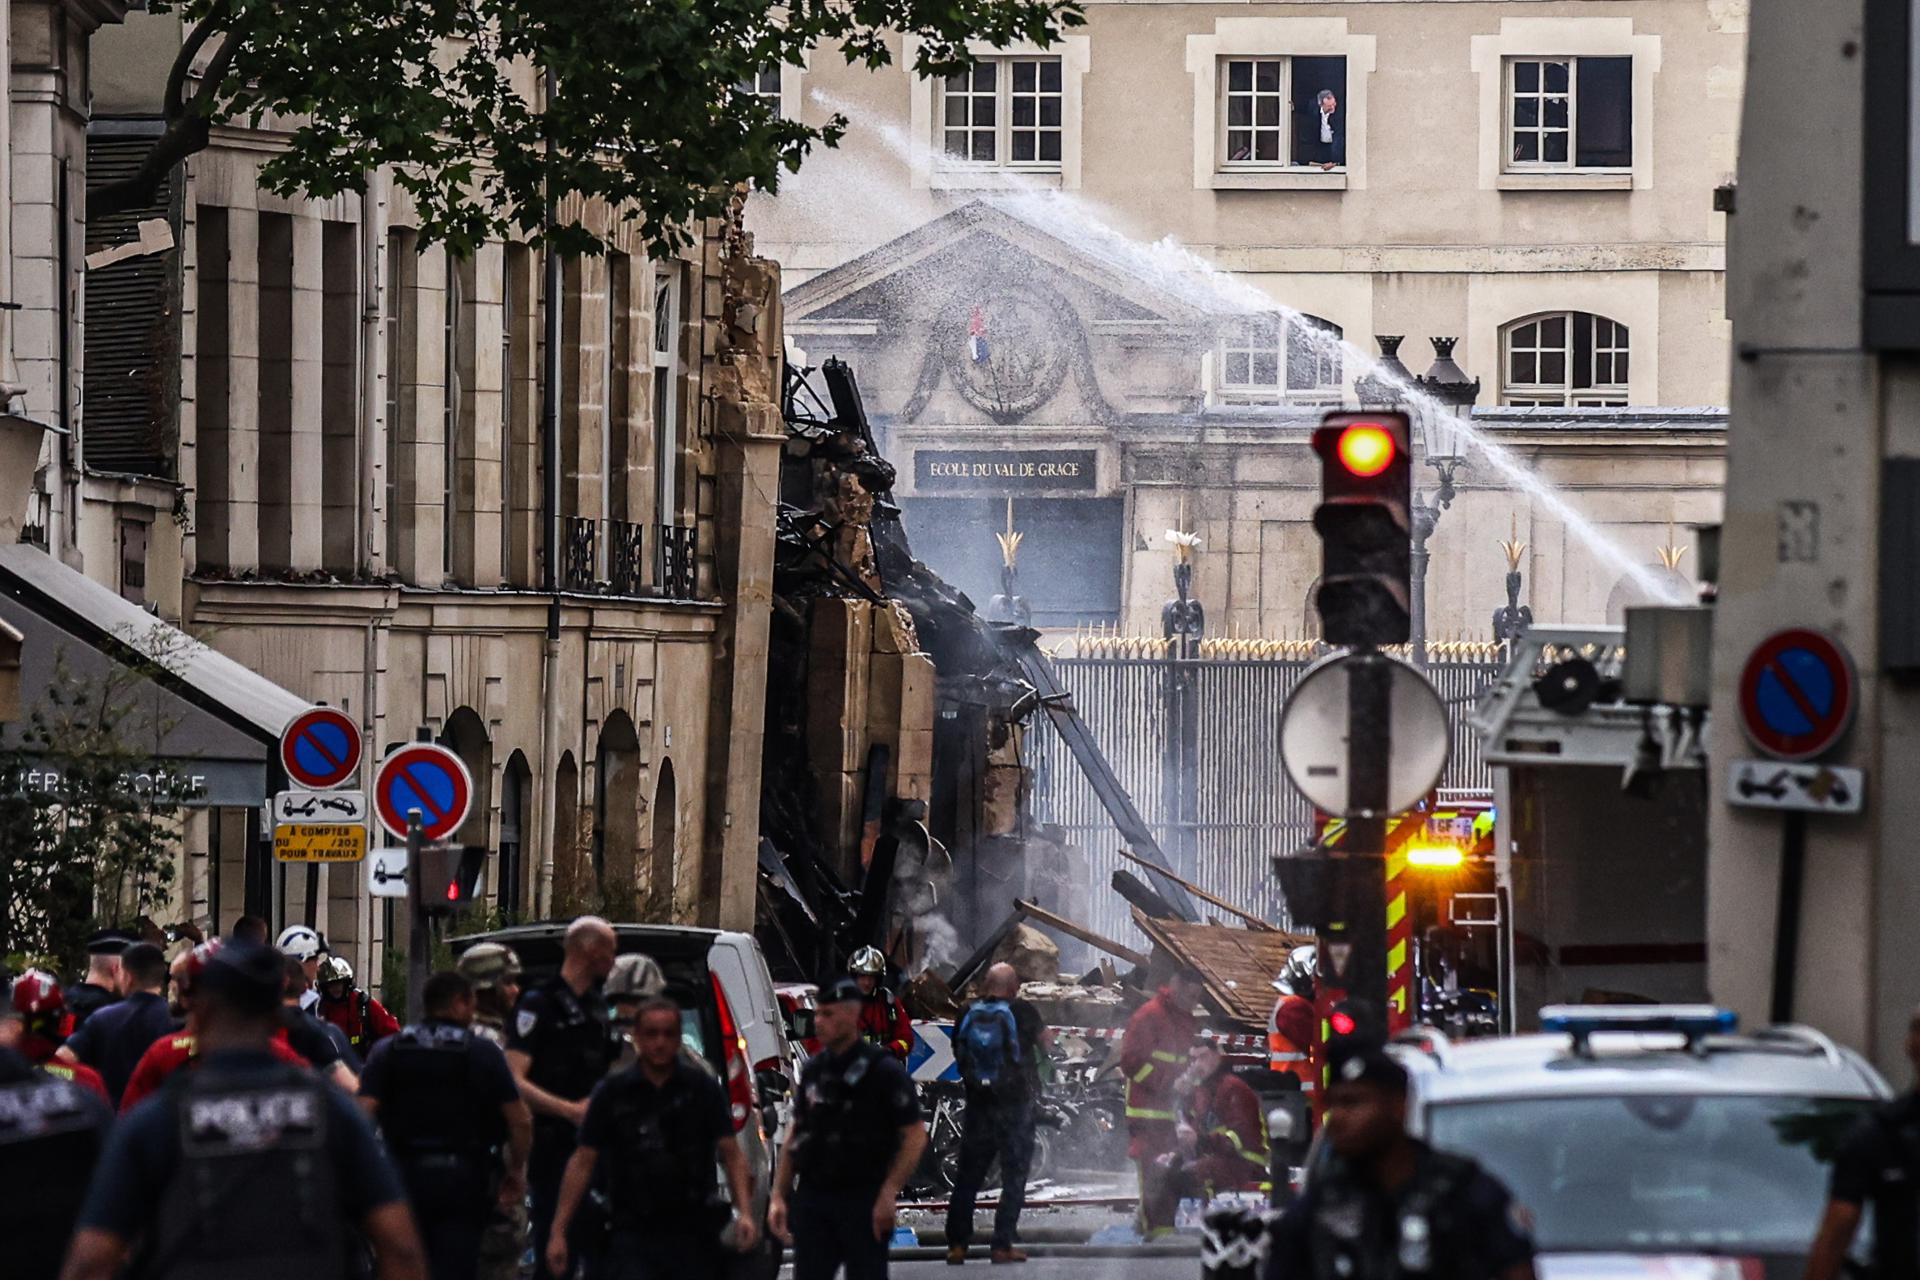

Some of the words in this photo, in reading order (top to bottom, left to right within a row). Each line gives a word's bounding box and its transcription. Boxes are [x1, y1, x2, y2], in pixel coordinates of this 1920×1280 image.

[973, 463, 991, 476] DU
[995, 463, 1017, 476] VAL
[1019, 463, 1035, 476] DE
[301, 827, 350, 836] COMPTER
[275, 838, 289, 847] DU
[280, 850, 307, 858] POUR
[313, 850, 357, 858] TRAVAUX
